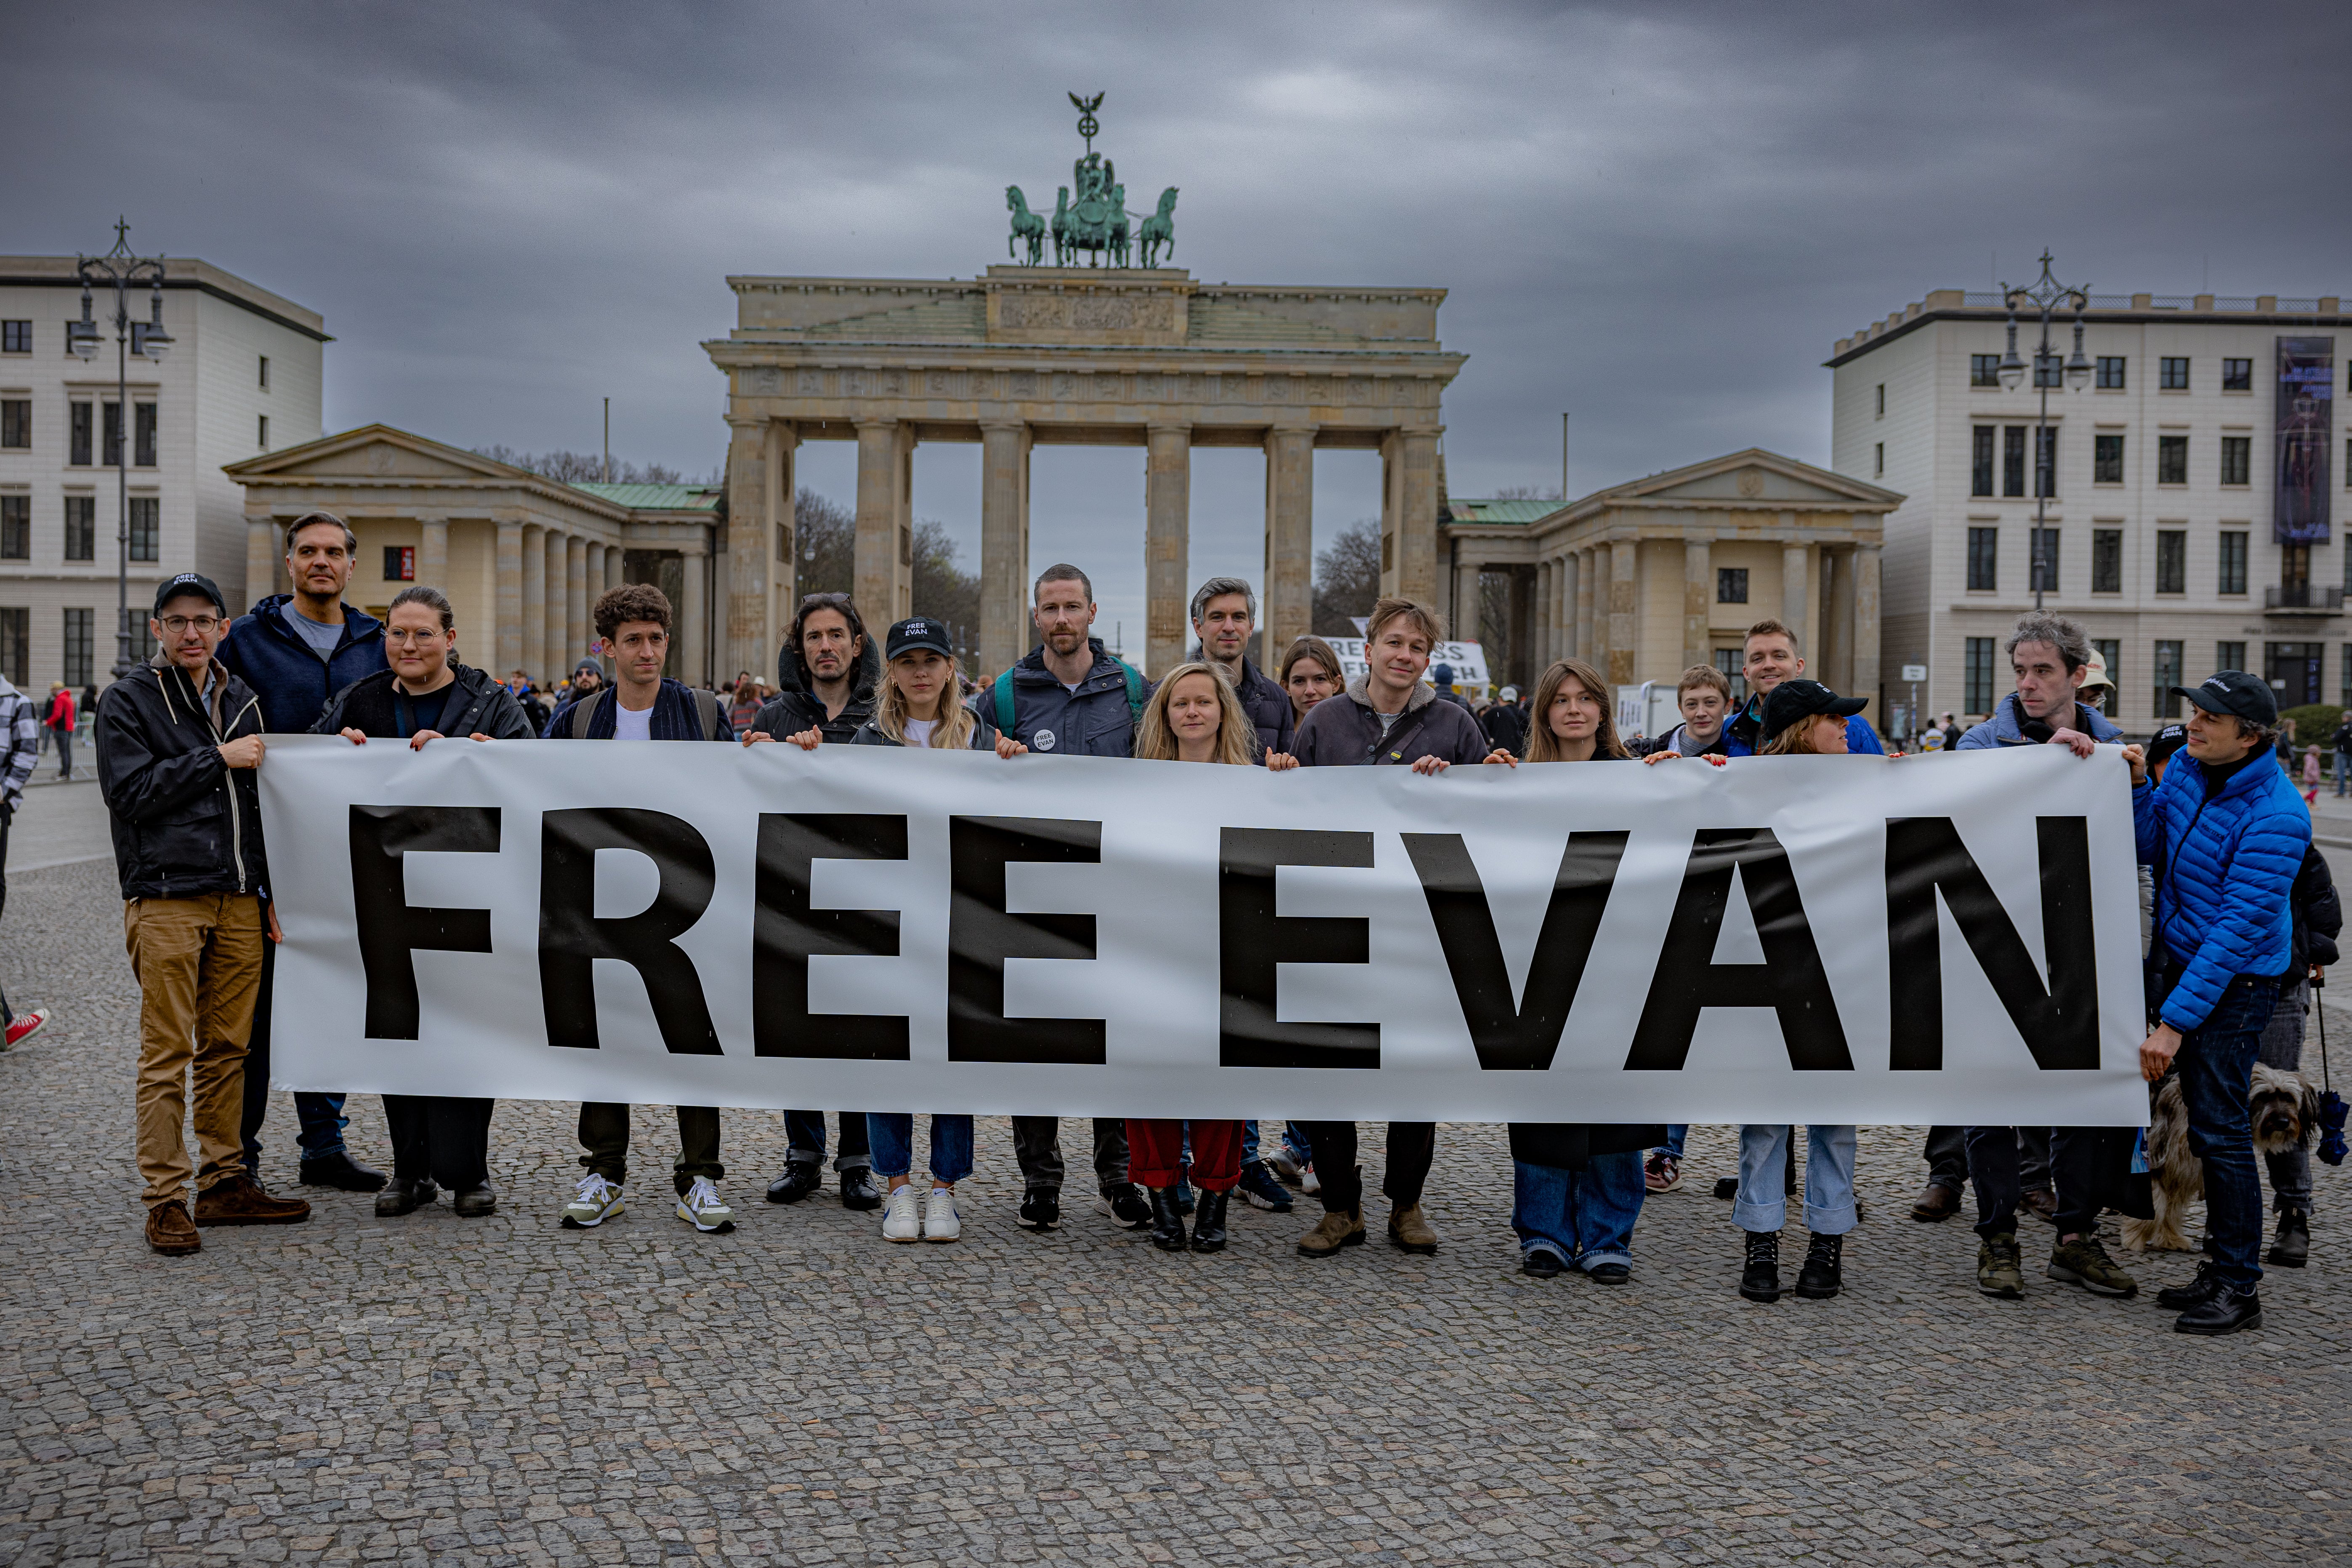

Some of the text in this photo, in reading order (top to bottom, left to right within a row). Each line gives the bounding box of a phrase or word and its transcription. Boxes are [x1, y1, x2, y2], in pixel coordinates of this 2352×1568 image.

[1036, 733, 1051, 741] FREE
[1038, 739, 1054, 747] EVAN
[349, 804, 2100, 1070] FREE EVAN
